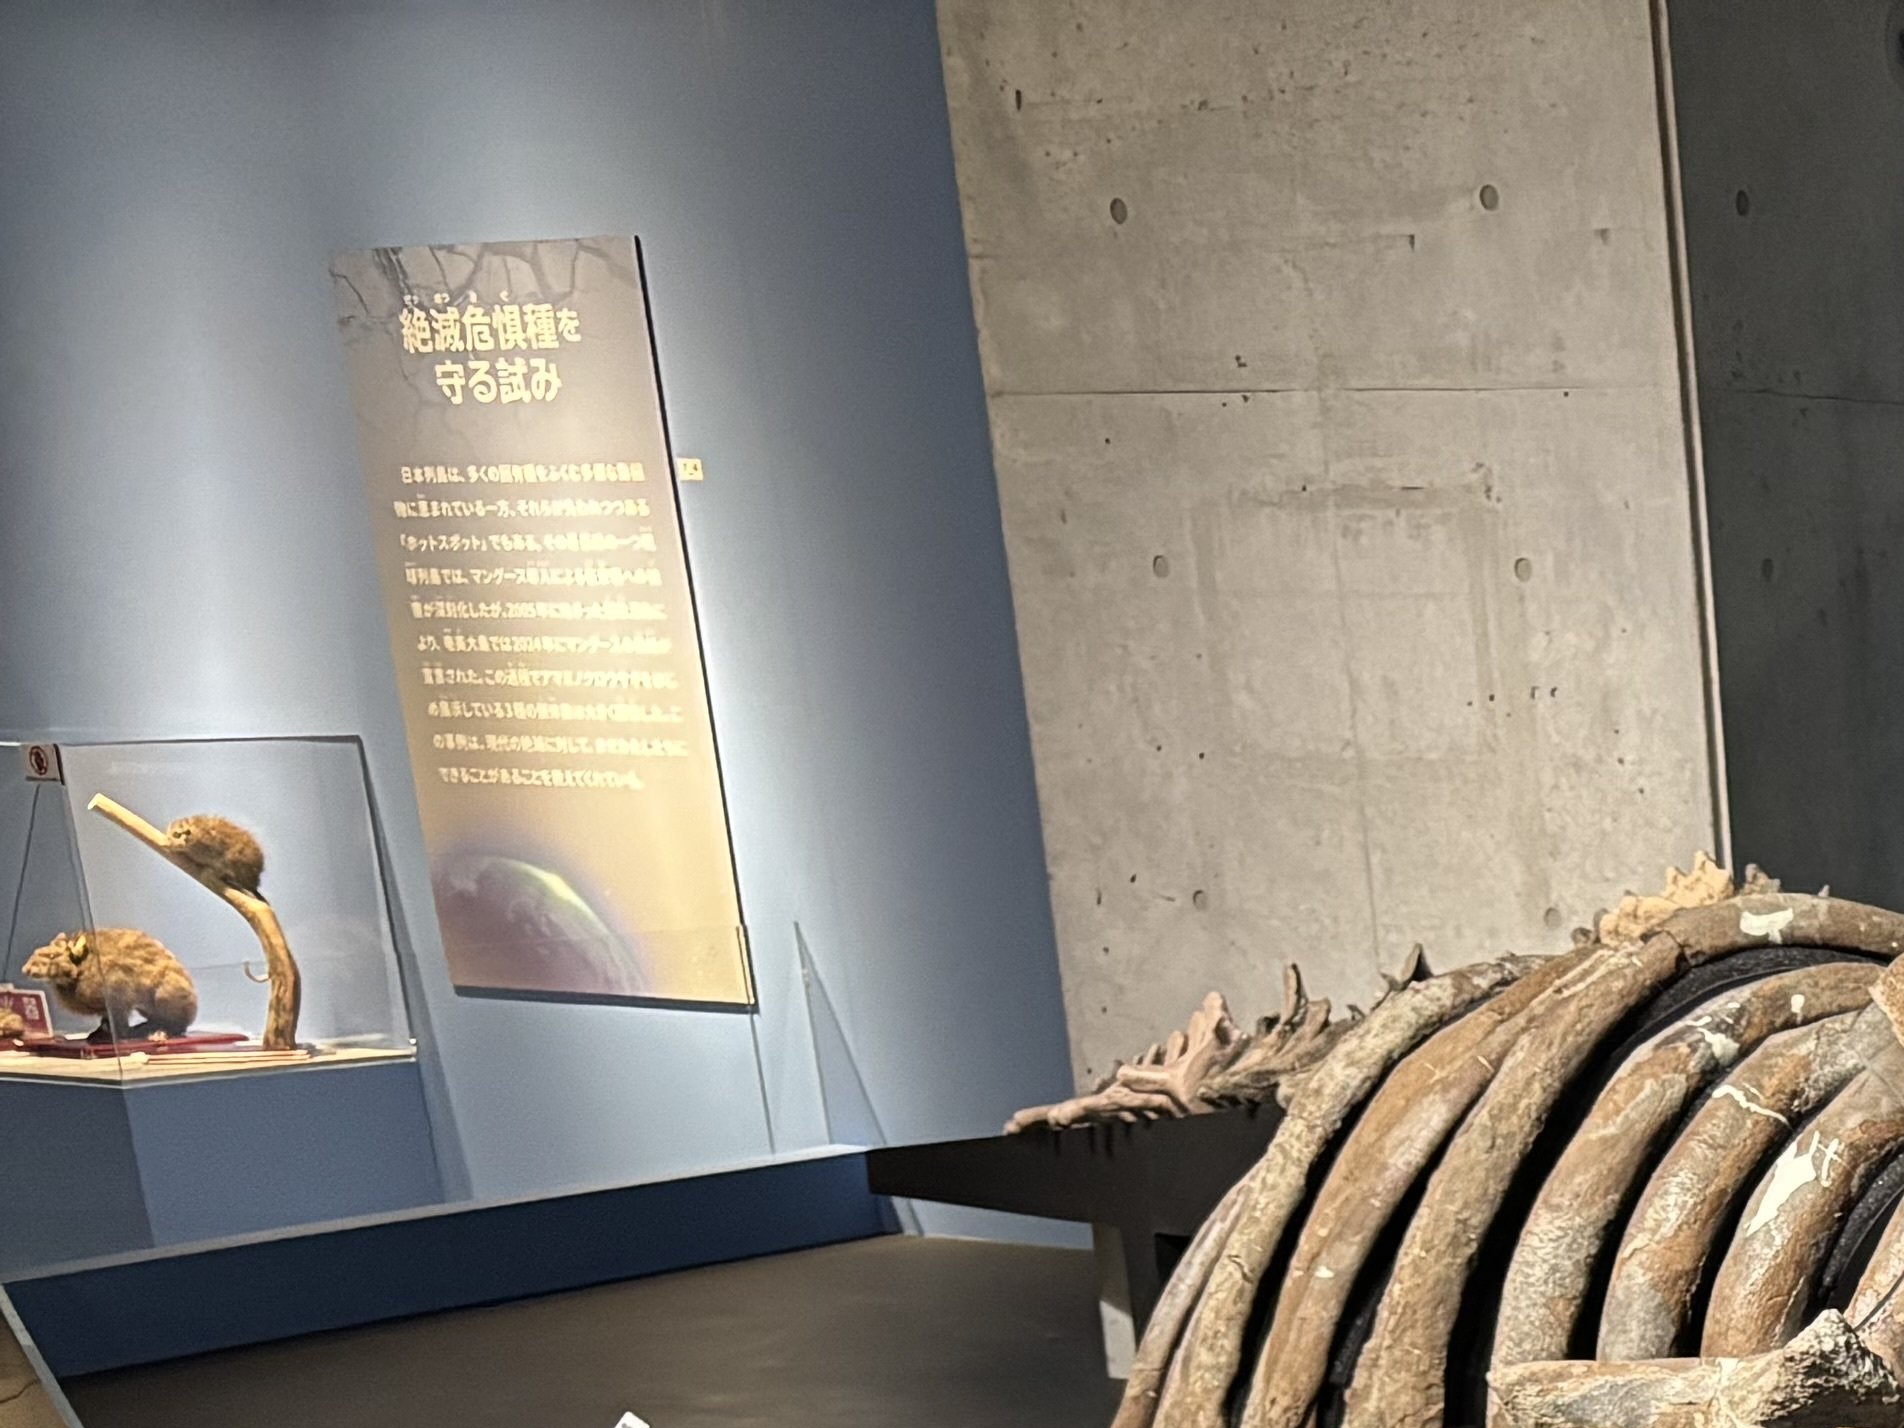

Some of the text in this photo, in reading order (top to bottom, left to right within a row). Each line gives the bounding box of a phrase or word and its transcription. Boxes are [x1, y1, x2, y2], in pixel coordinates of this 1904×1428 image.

[399, 303, 582, 353] 絶滅危惧種を
[434, 360, 563, 405] 守る試み
